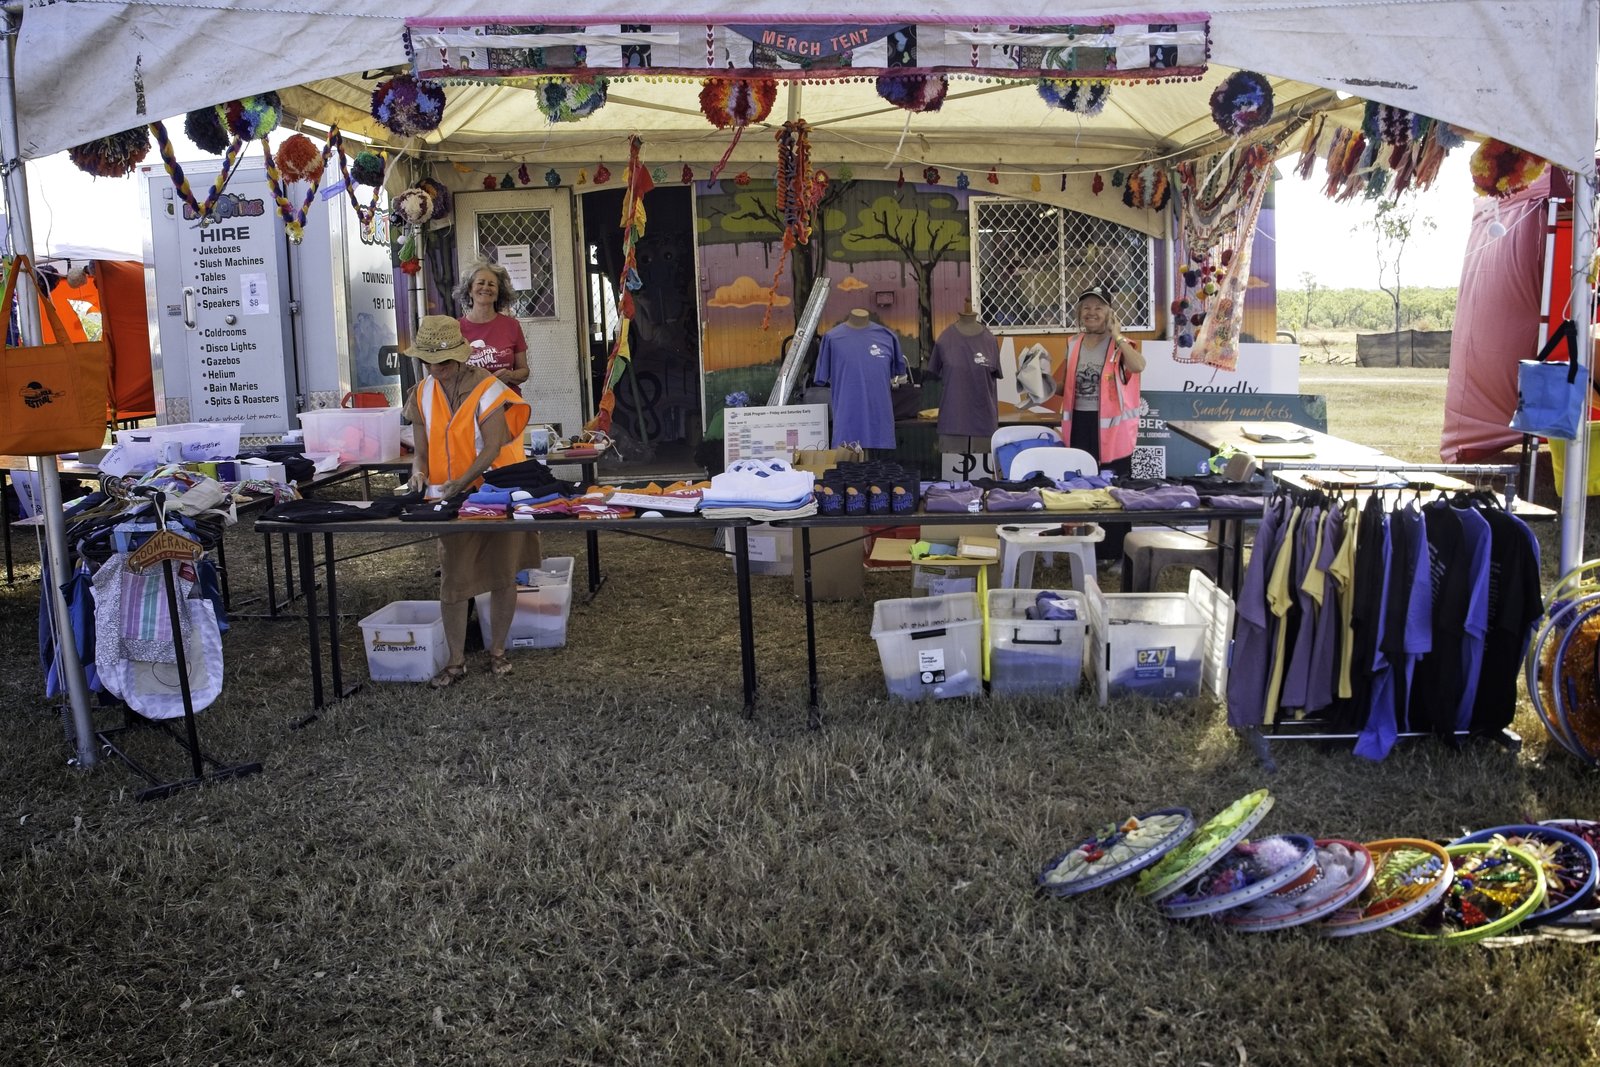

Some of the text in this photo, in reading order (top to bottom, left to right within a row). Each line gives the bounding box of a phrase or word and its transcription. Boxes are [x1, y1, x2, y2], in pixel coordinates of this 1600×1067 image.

[762, 28, 869, 56] MERCH TENT
[200, 226, 250, 243] HIRE
[199, 245, 241, 256] Jukeboxes
[200, 256, 264, 269] Slush Machines
[201, 273, 226, 282] Tables
[201, 286, 228, 296] Chairs
[202, 299, 240, 310] Speakers
[249, 299, 259, 307] $8
[372, 298, 385, 310] 191
[204, 328, 247, 338] Coldrooms
[206, 342, 257, 353] Disco Lights
[206, 356, 241, 367] Gazebos
[386, 352, 400, 370] 47
[208, 370, 236, 379] Helium
[209, 382, 258, 393] Bain Maries
[210, 394, 280, 407] Spits & Roasters
[1192, 399, 1236, 421] Sunday
[1138, 650, 1167, 666] ezy
